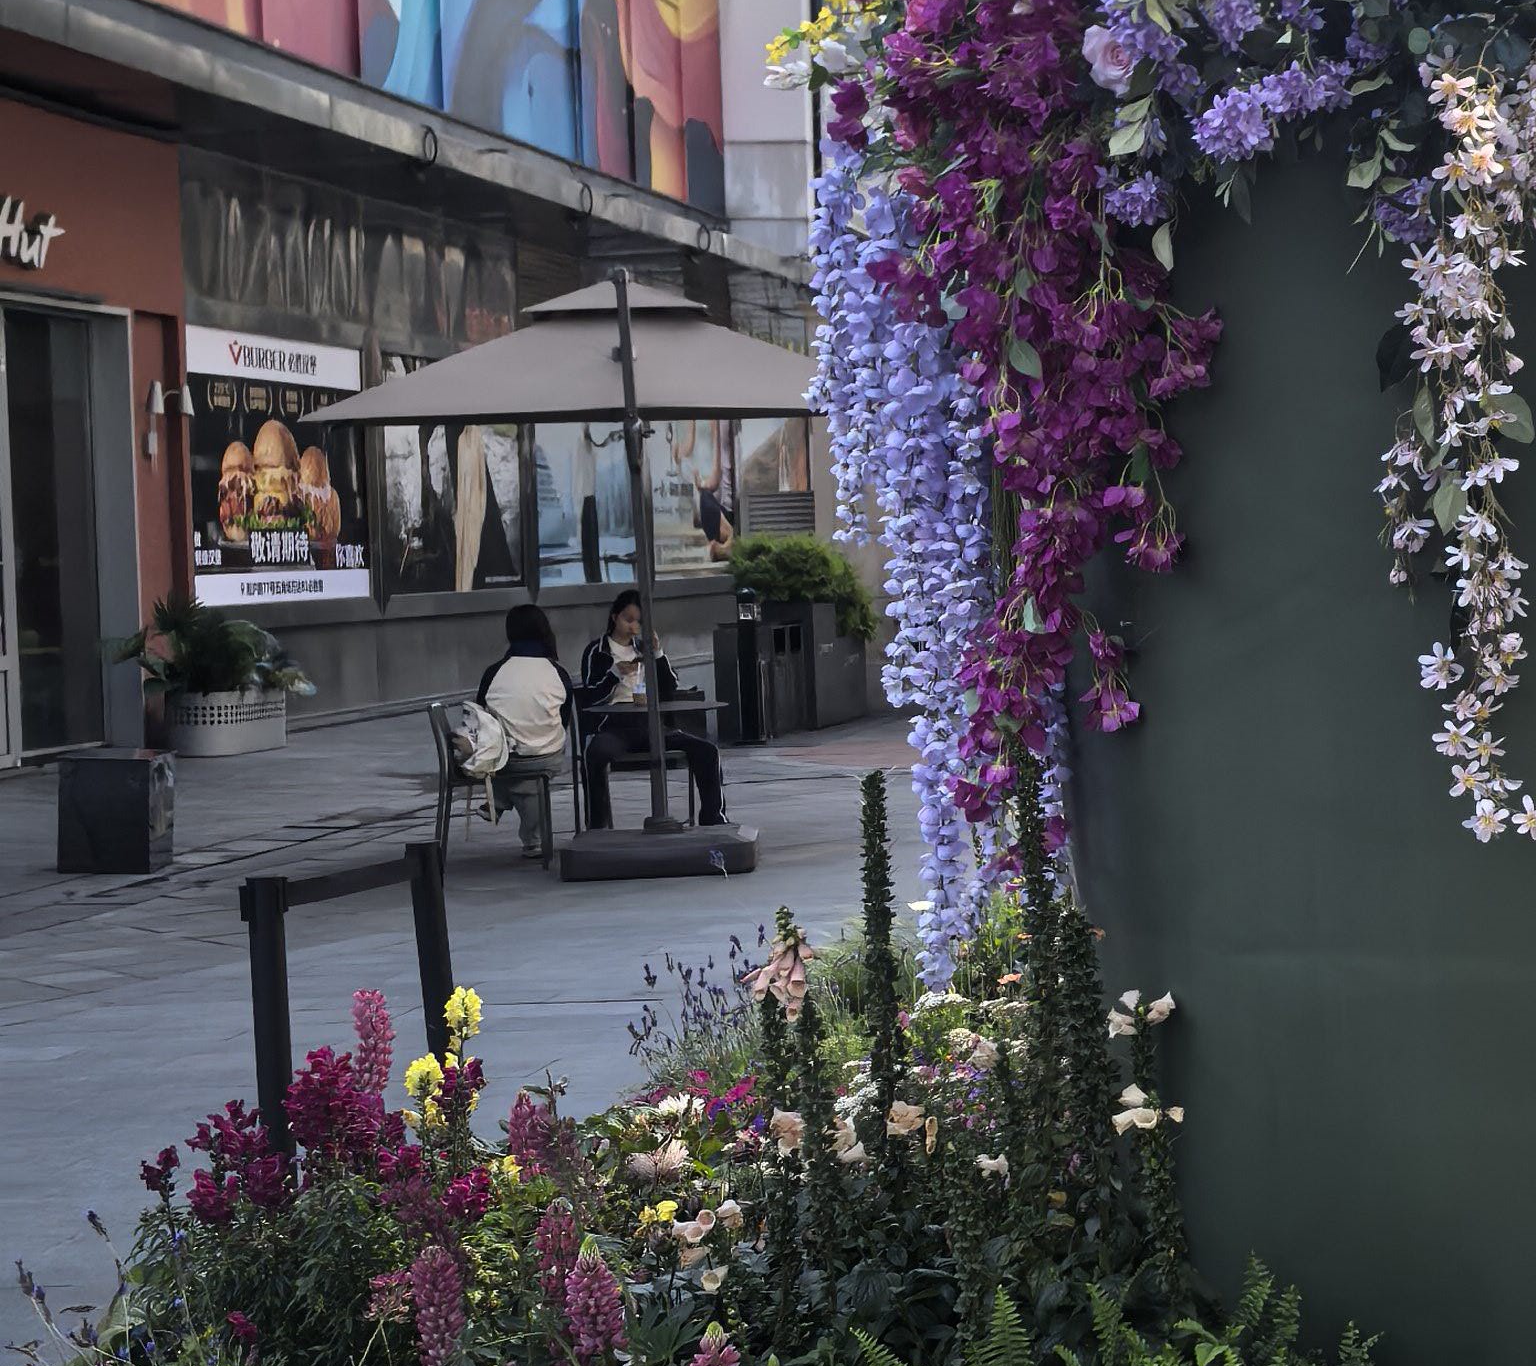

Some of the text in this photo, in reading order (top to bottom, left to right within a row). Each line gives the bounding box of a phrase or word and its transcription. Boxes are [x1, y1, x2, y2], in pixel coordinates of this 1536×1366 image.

[0, 195, 66, 269] Hut
[250, 531, 310, 563] 敬请期待
